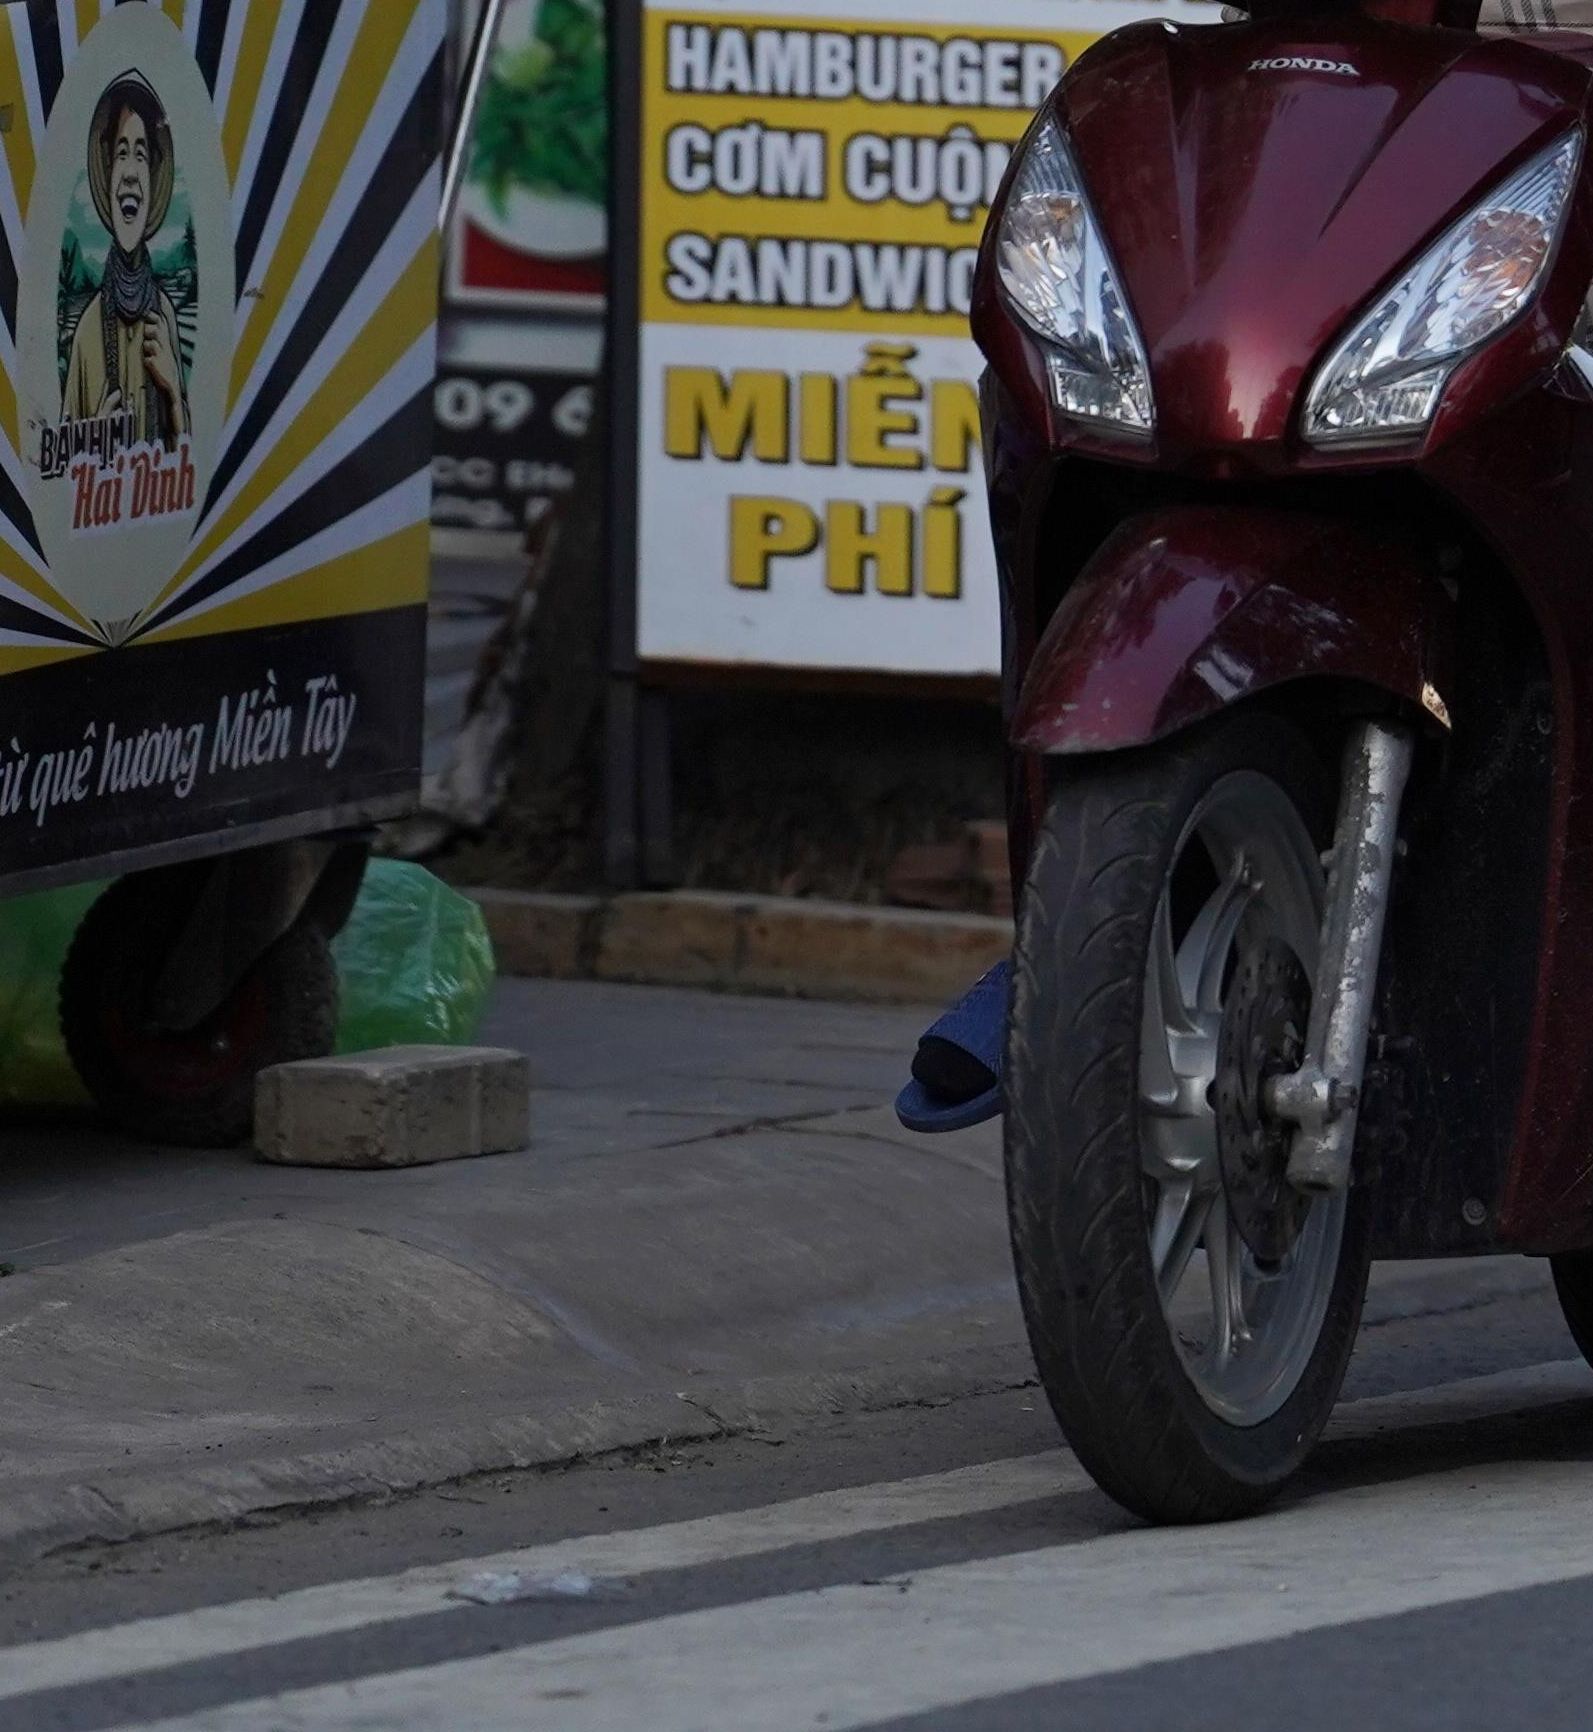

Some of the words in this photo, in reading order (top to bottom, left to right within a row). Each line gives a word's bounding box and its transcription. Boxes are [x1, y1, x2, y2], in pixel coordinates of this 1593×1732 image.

[663, 22, 1066, 108] HAMBURGER
[1247, 57, 1361, 77] HONDA
[664, 118, 828, 200] CƠM
[70, 454, 125, 530] Hai
[129, 442, 196, 520] Dinh
[727, 487, 966, 599] PHÍ
[30, 721, 98, 827] quê
[97, 720, 205, 799] hương
[210, 668, 293, 777] Miền
[301, 673, 358, 770] Tây
